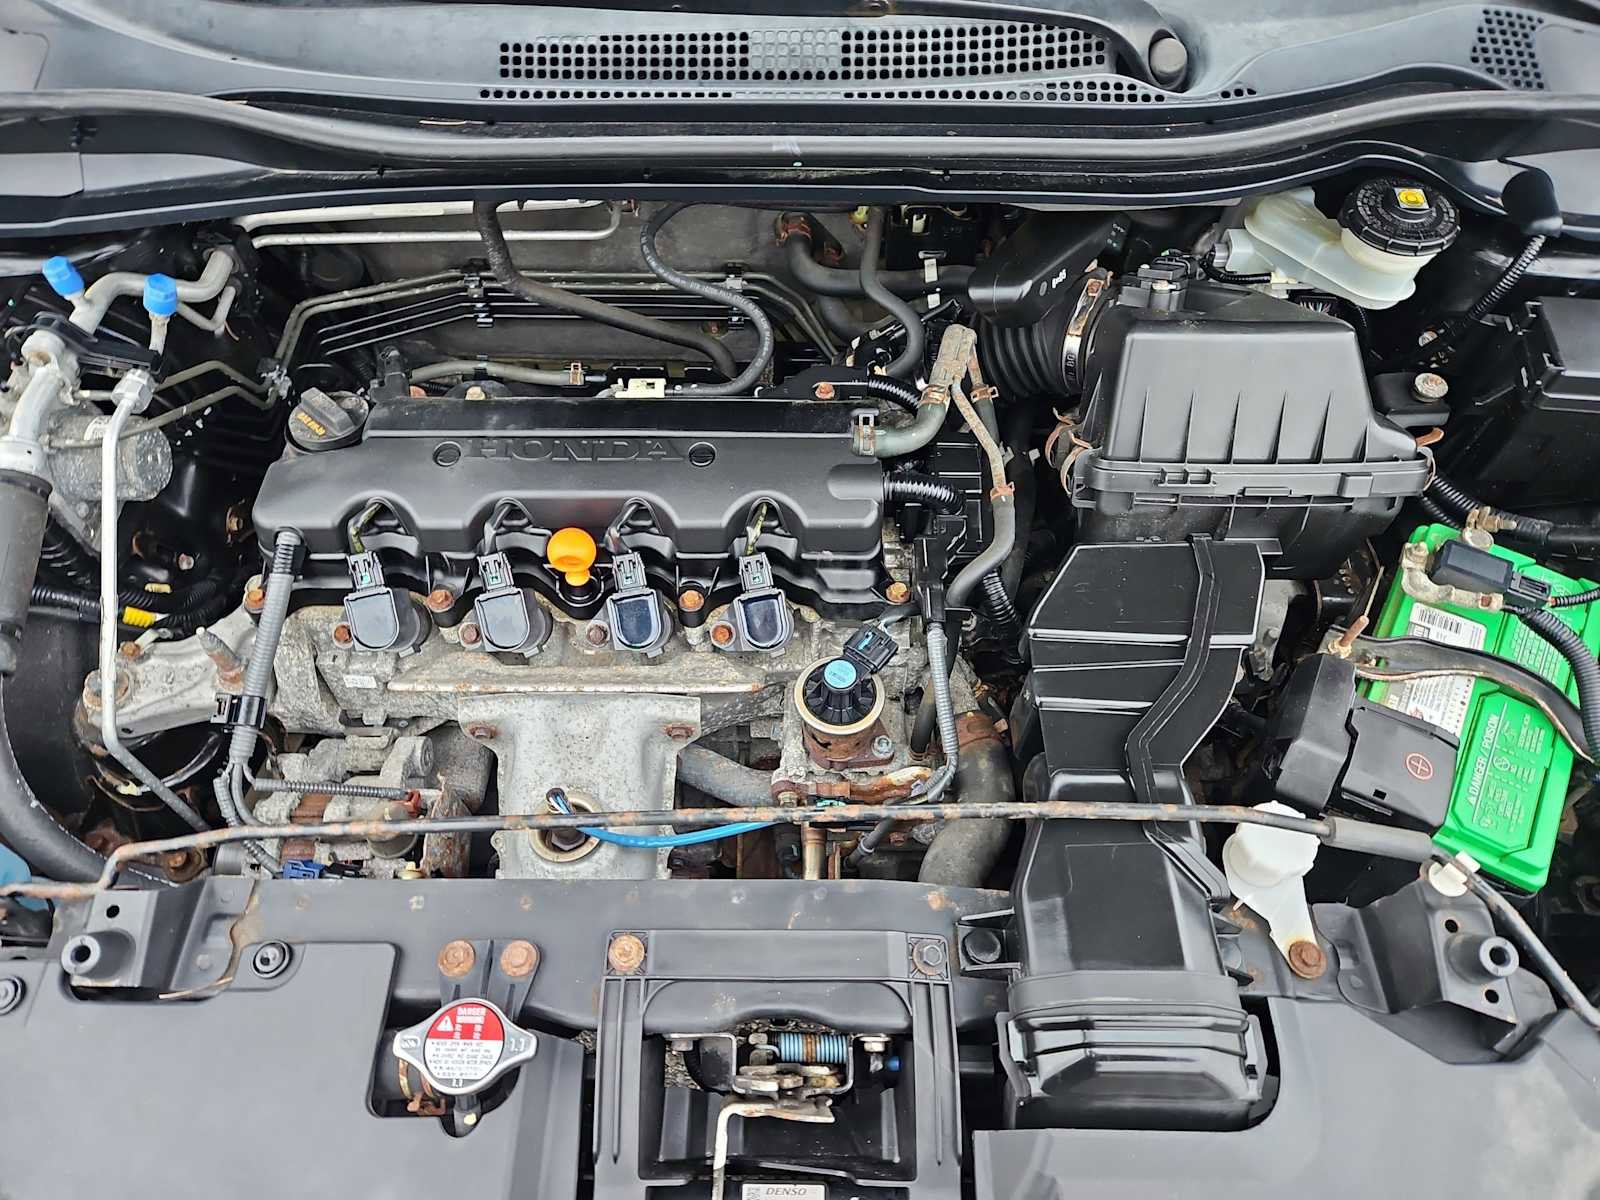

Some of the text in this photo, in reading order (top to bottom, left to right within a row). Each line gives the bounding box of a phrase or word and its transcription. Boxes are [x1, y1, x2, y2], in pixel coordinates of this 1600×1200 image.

[464, 439, 684, 462] HONDA
[1468, 756, 1486, 795] DANGER
[1481, 713, 1500, 748] POISON
[766, 1187, 807, 1196] DENSO
